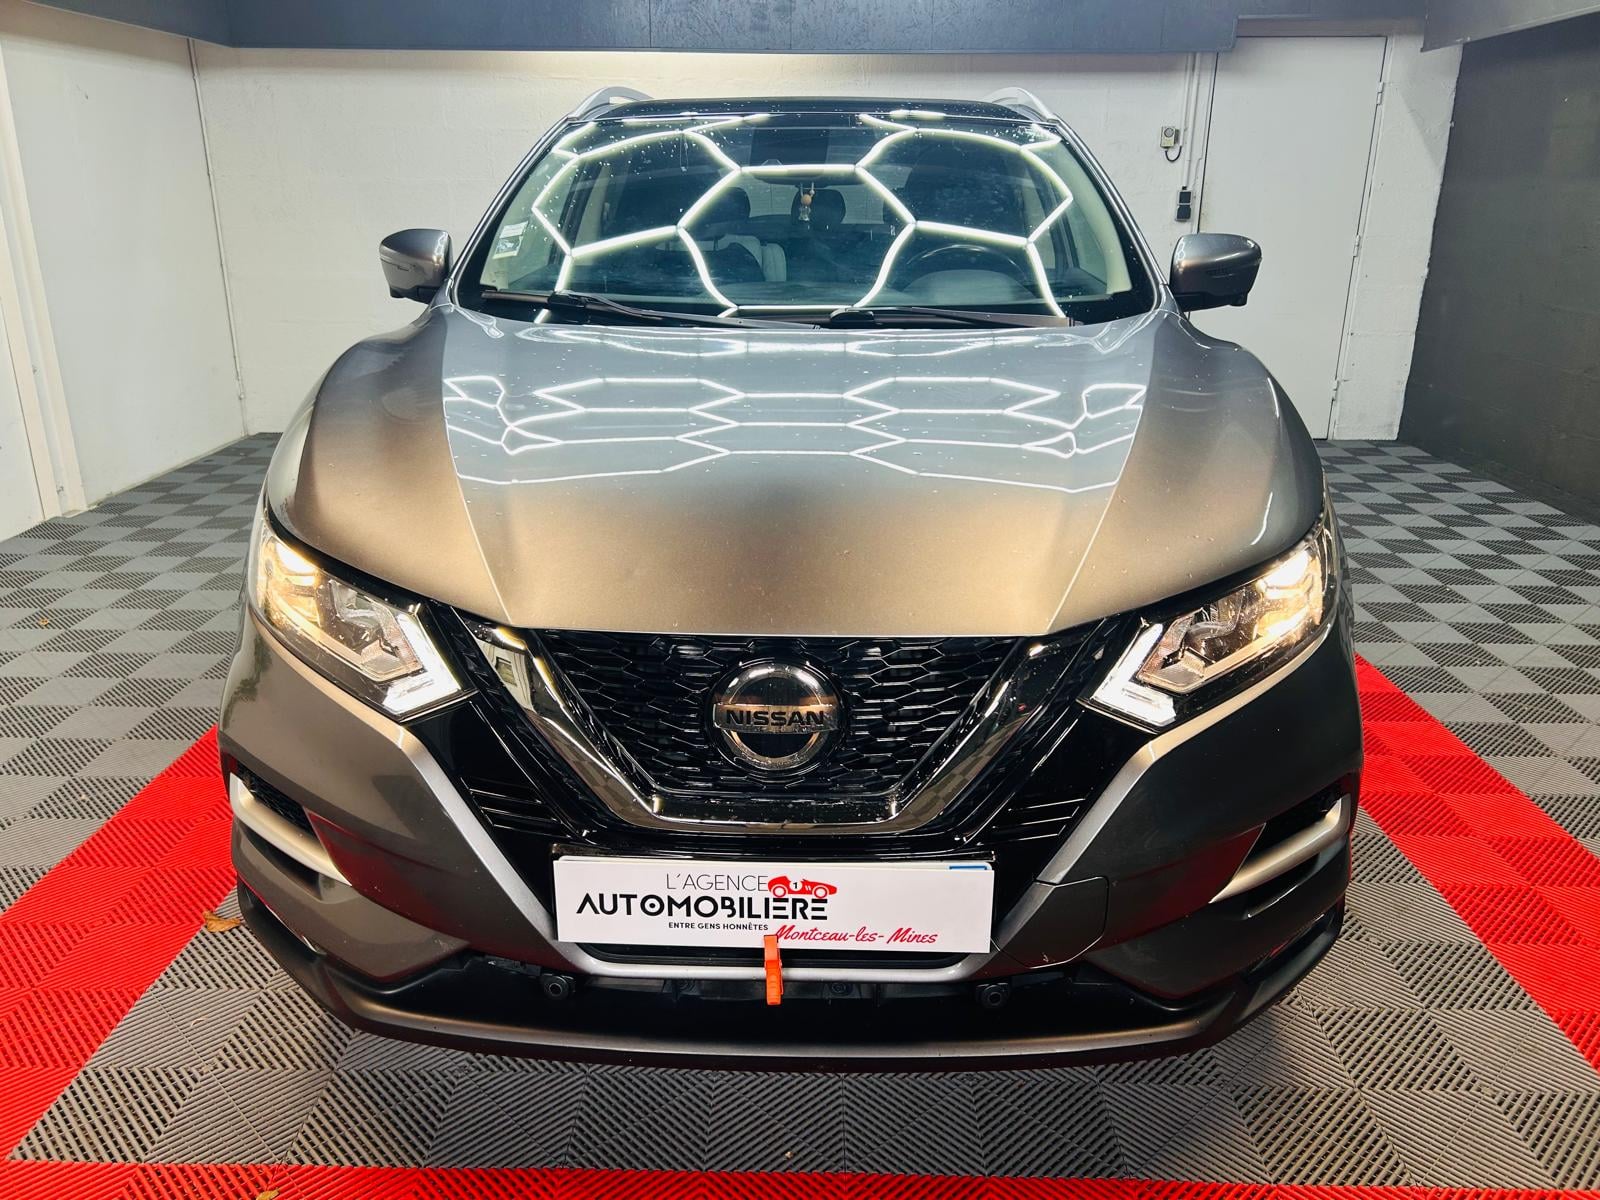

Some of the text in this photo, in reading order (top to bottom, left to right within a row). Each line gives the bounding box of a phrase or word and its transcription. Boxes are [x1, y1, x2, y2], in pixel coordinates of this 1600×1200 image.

[725, 709, 824, 727] NISSAN
[666, 873, 769, 892] L'AGENCE
[792, 881, 799, 890] 1
[668, 921, 769, 932] ENTRE GENS HONNÊTES
[886, 927, 939, 945] Mines
